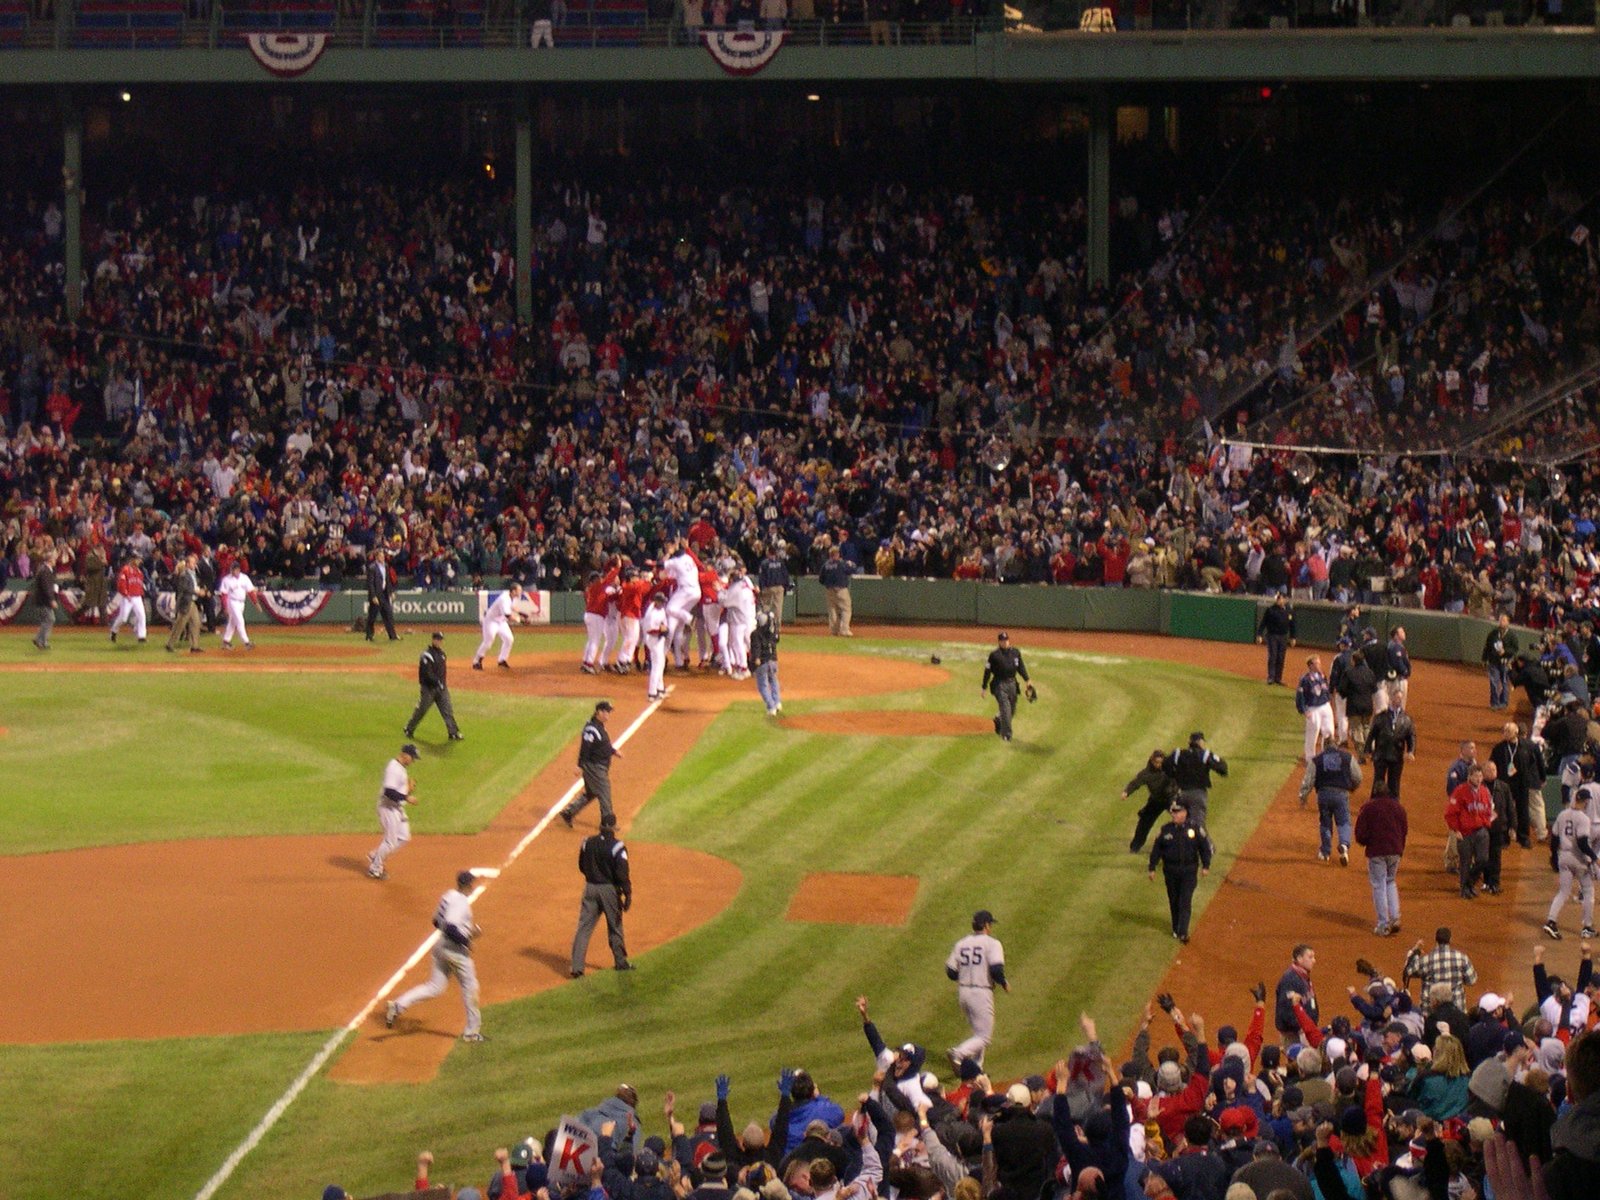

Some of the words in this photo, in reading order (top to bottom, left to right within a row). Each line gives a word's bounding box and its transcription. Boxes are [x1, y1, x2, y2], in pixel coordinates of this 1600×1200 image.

[363, 600, 465, 615] rsox.com
[960, 946, 983, 966] 55
[559, 1137, 591, 1175] K
